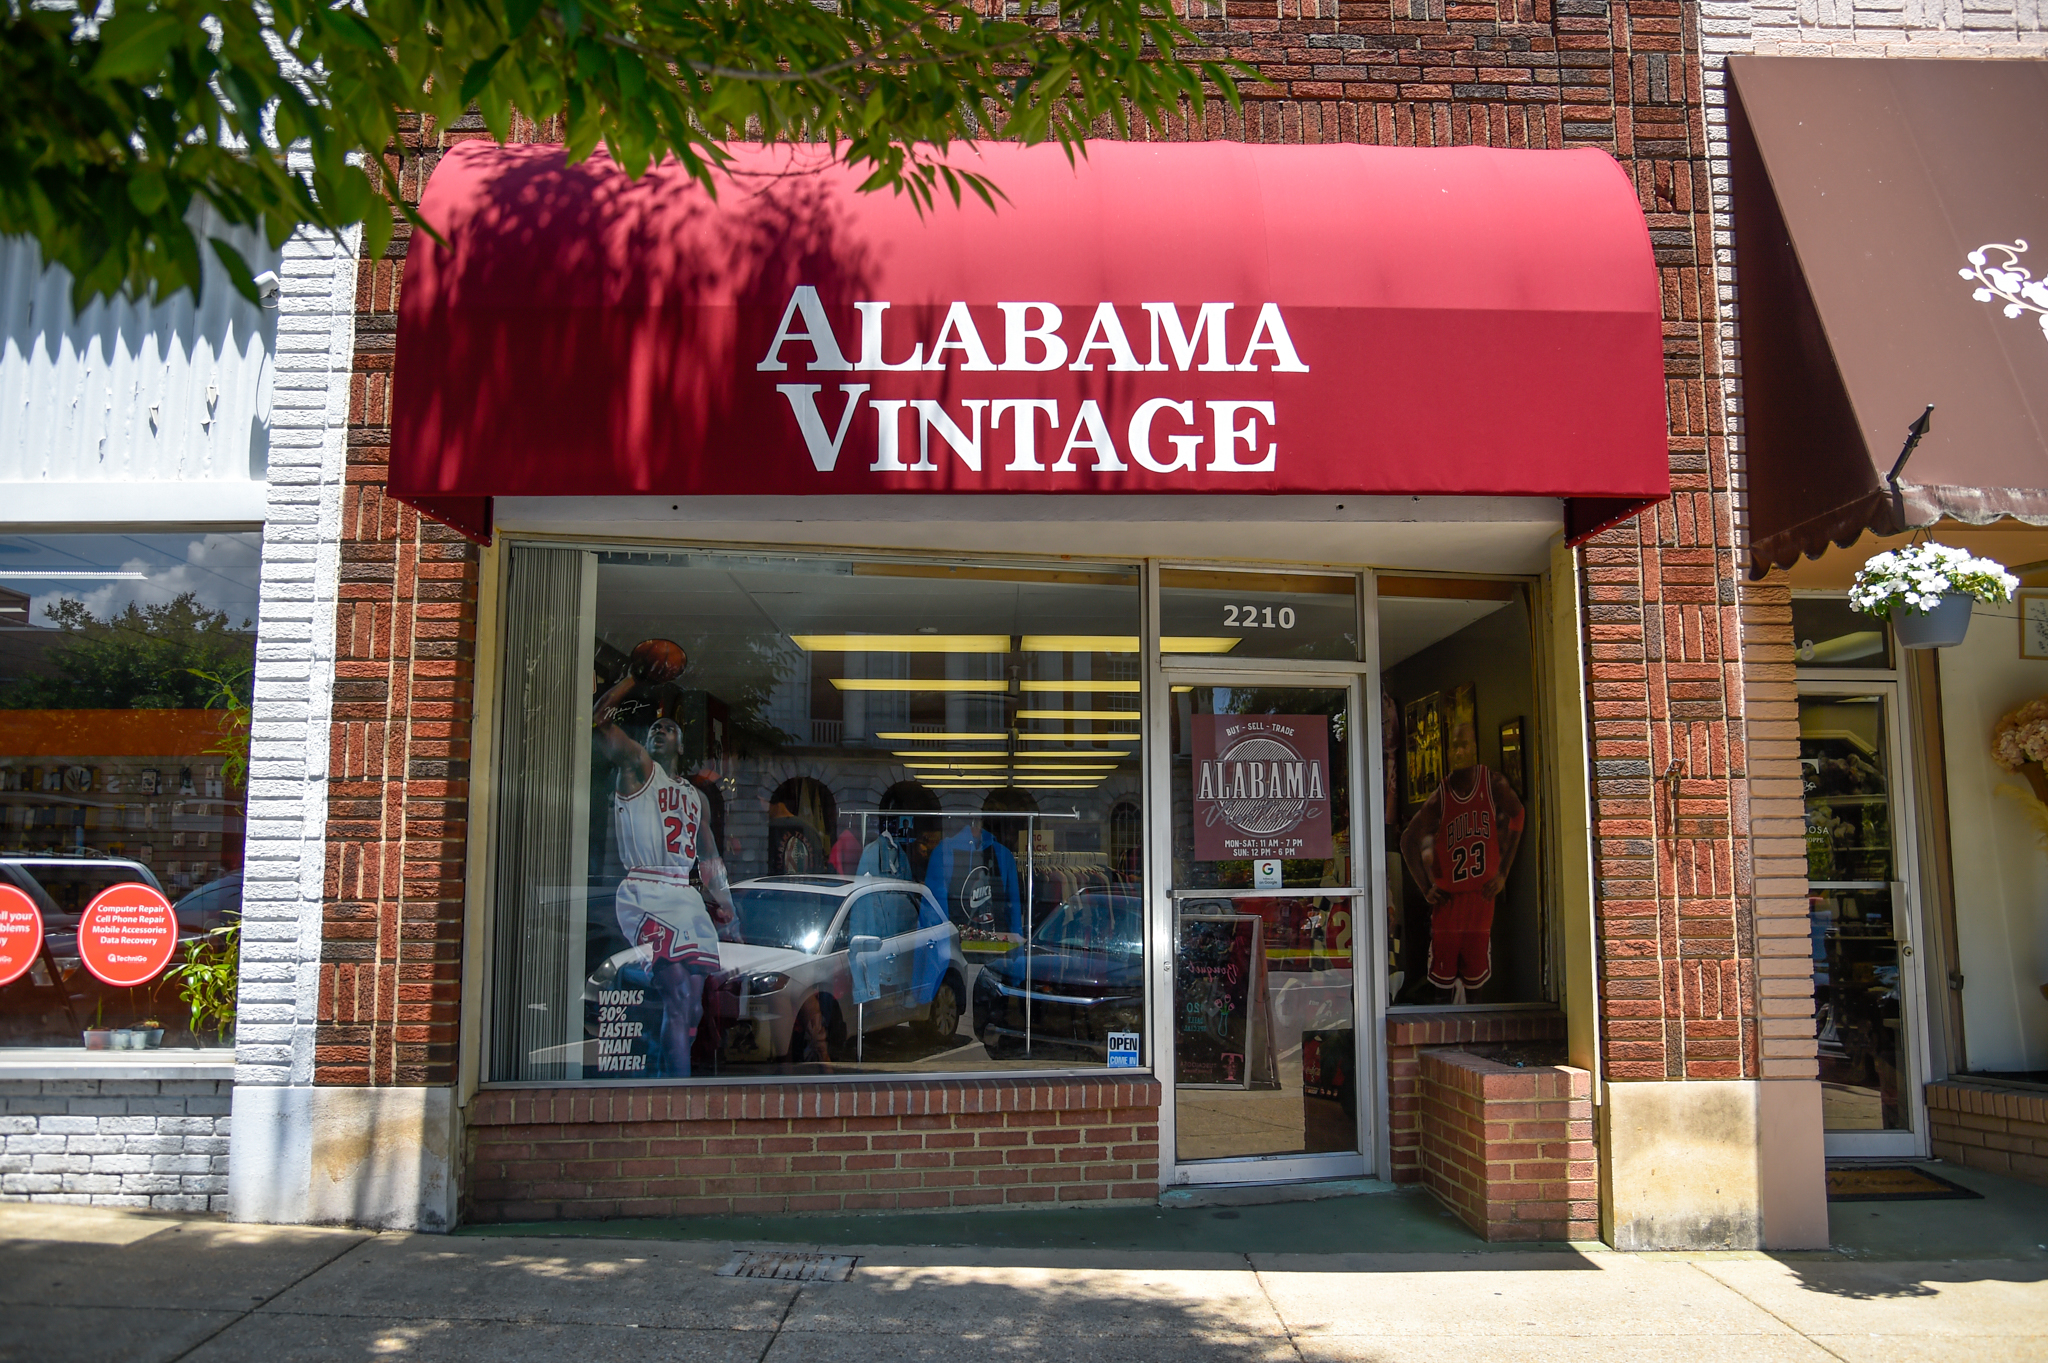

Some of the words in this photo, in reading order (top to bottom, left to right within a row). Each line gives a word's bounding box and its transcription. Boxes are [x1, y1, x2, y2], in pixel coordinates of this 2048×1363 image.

[756, 285, 1309, 373] ALABAMA
[776, 383, 1278, 473] VINTAGE
[1223, 604, 1296, 629] 2210
[1225, 725, 1240, 737] BUY
[1247, 722, 1265, 731] SELL
[1271, 723, 1295, 737] TRADE
[1197, 761, 1325, 800] ALABAMA
[664, 816, 697, 861] 23
[1446, 810, 1490, 851] BULLS
[1224, 839, 1258, 848] MON-SAT:
[1268, 839, 1279, 847] AM
[1286, 839, 1291, 847] 7
[1292, 839, 1303, 847] PM
[1232, 848, 1250, 857] SUN:
[1251, 848, 1259, 856] 12
[1260, 848, 1271, 856] PM
[1278, 848, 1283, 856] 6
[1284, 848, 1295, 856] PM
[1451, 840, 1486, 883] 23
[9, 912, 33, 923] your
[97, 904, 137, 915] Computer
[138, 905, 165, 915] Repair
[95, 915, 111, 924] Cell
[112, 915, 137, 924] Phone
[138, 916, 165, 926] Repair
[92, 926, 120, 934] Mobile
[121, 926, 167, 935] Accessories
[100, 936, 119, 945] Data
[120, 936, 158, 946] Recovery
[117, 954, 148, 963] TechniGo
[598, 989, 645, 1006] WORKS
[597, 1005, 628, 1022] 30%
[598, 1021, 644, 1038] FASTER
[597, 1038, 633, 1055] THAN
[1109, 1037, 1137, 1050] OPEN
[597, 1054, 647, 1072] WATER!
[1110, 1055, 1128, 1065] COME
[1129, 1056, 1137, 1065] IN
